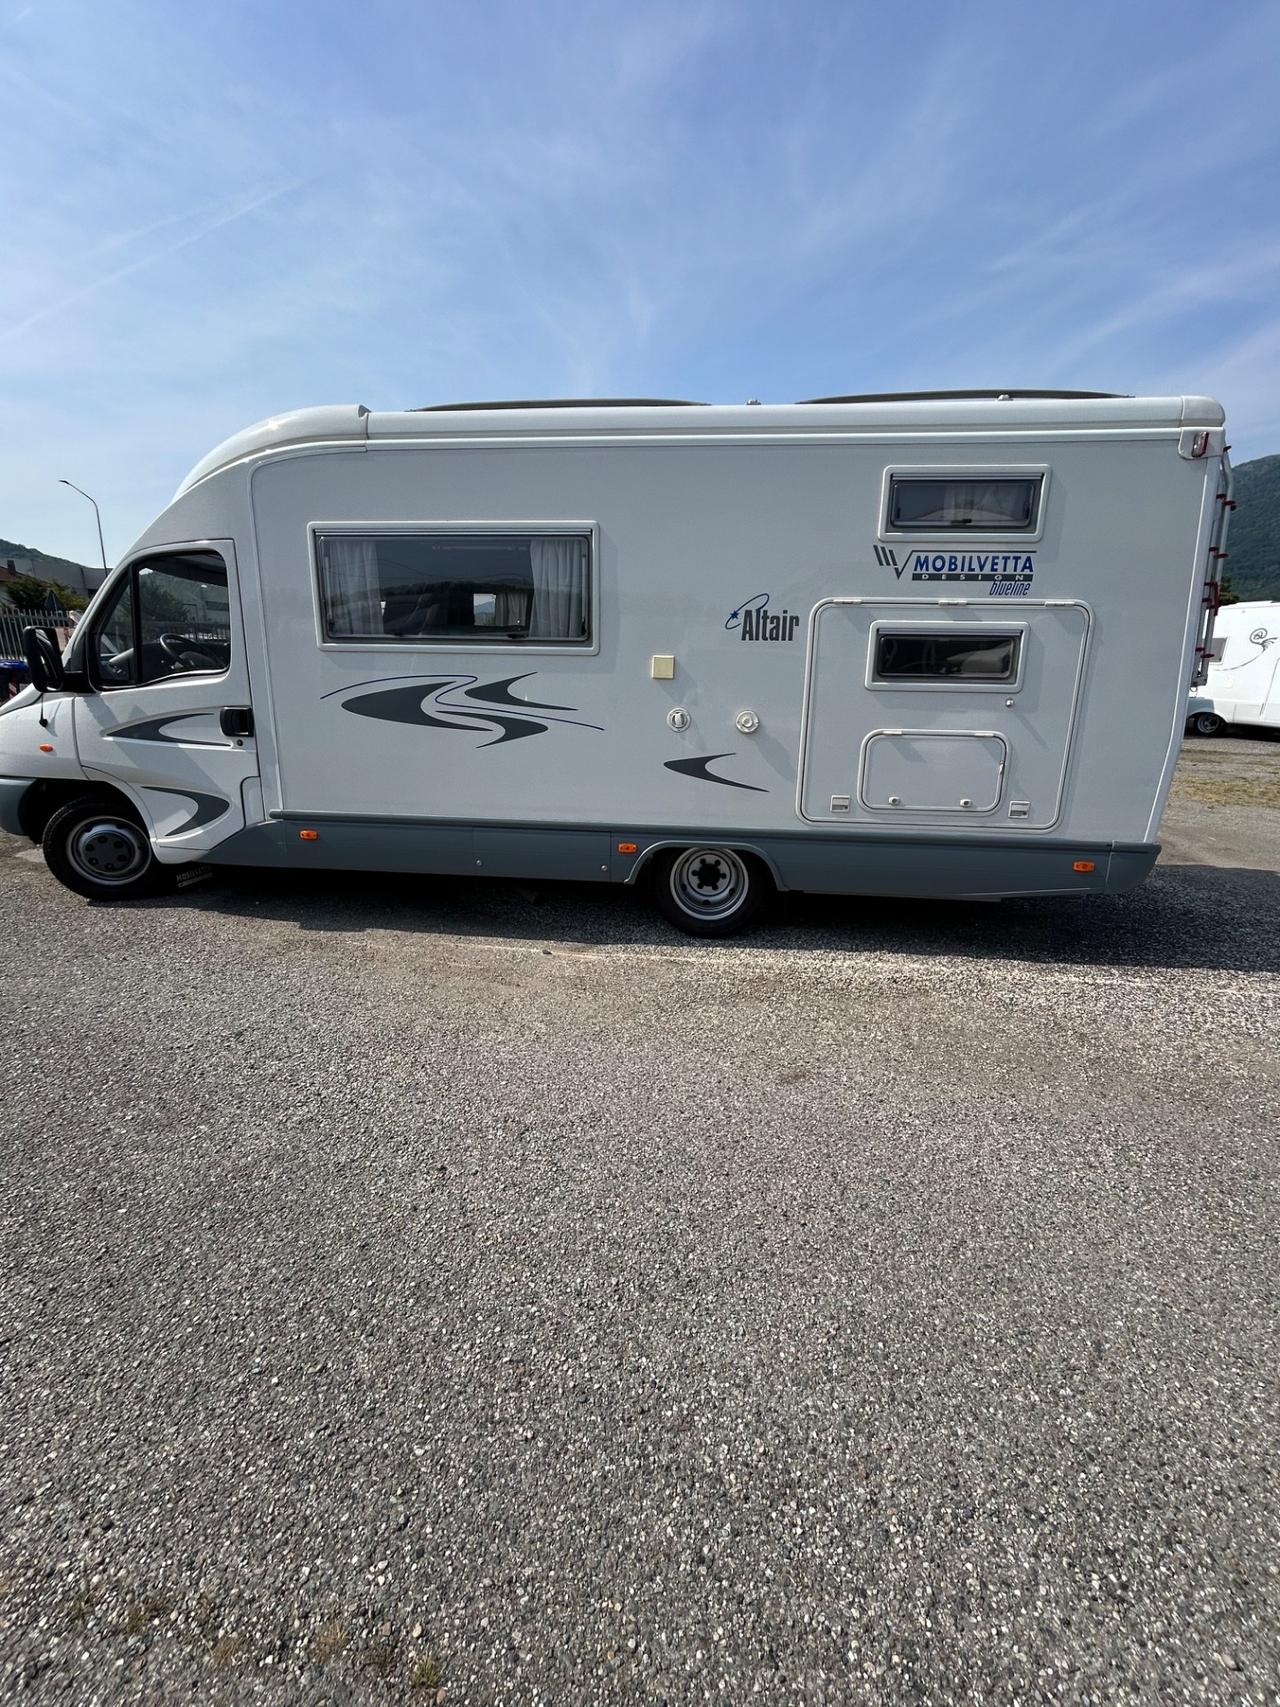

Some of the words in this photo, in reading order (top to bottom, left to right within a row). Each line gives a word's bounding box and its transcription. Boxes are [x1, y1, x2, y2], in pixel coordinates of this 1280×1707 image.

[913, 555, 1034, 573] MOBILVETTA
[989, 580, 1031, 596] blueline
[741, 609, 800, 641] Altair
